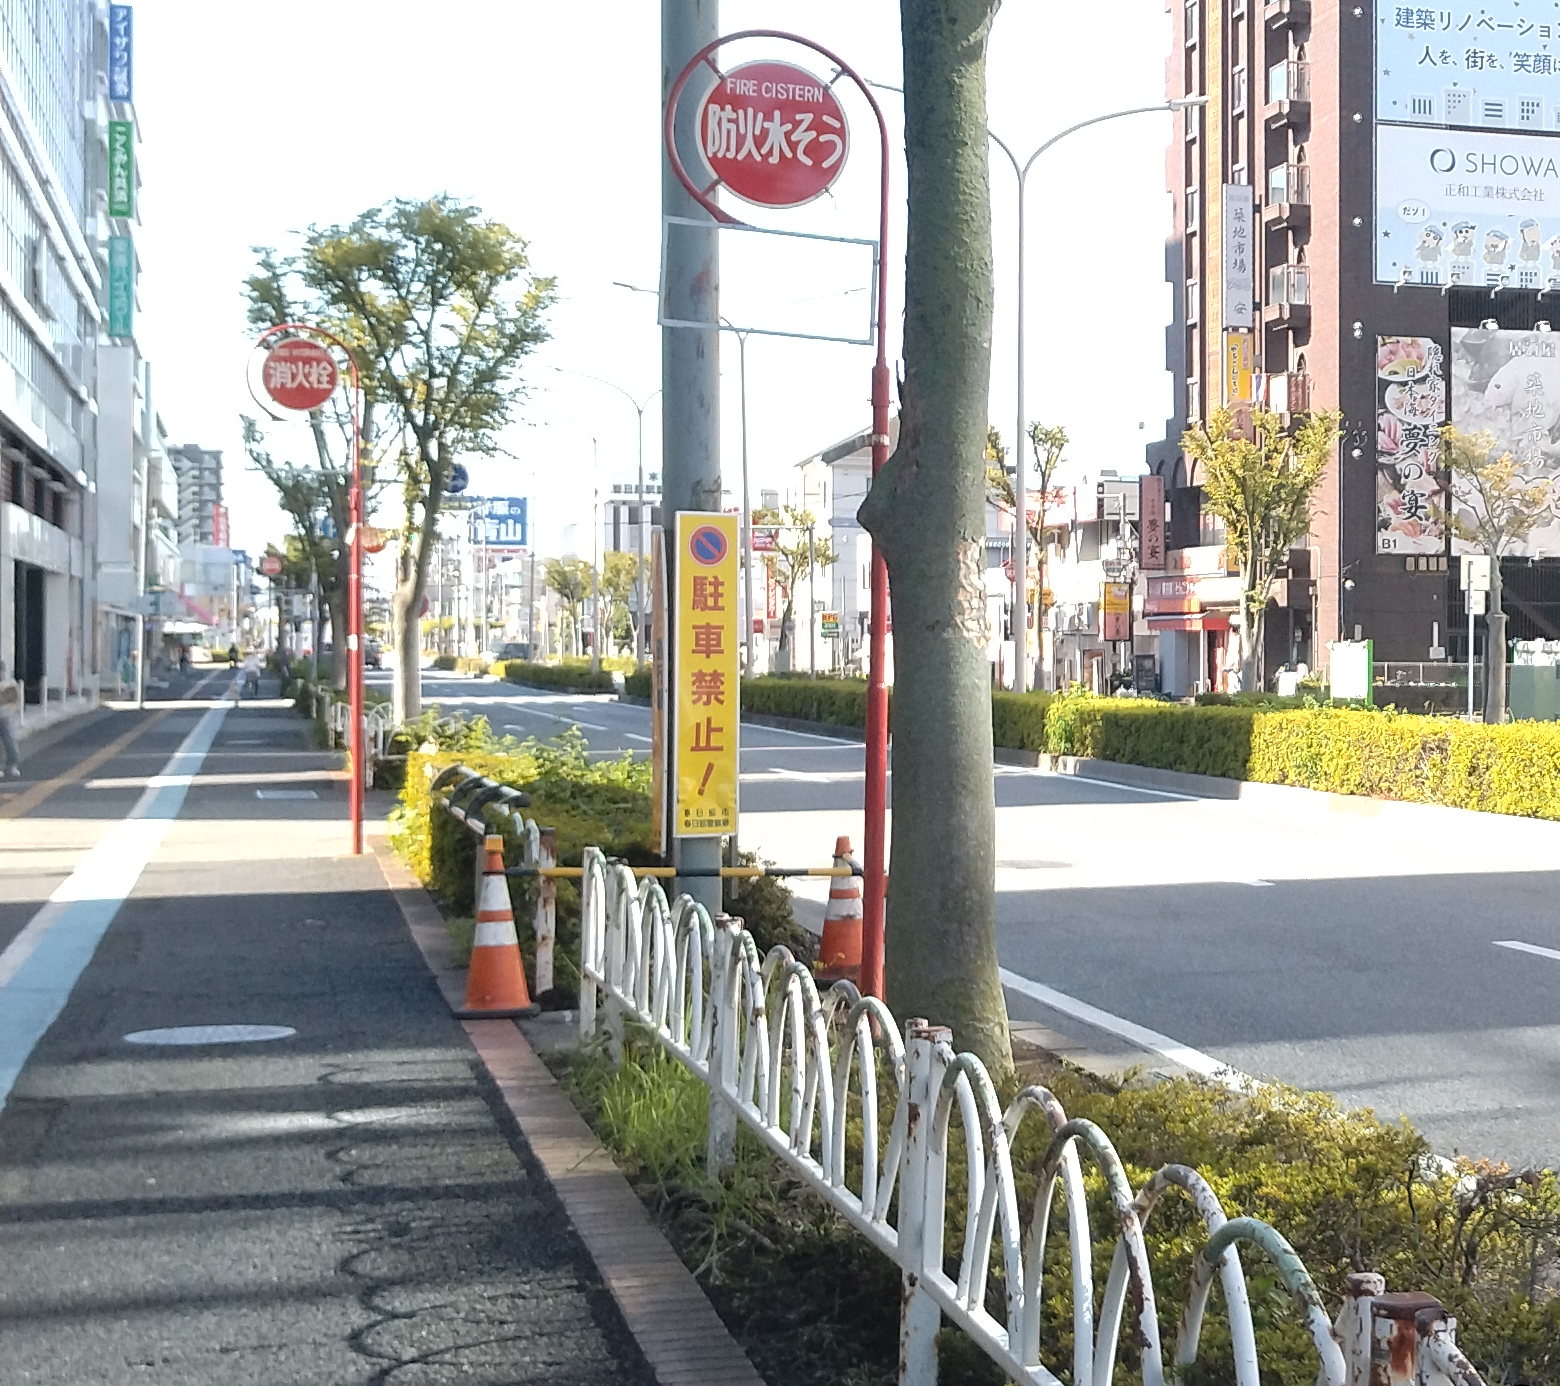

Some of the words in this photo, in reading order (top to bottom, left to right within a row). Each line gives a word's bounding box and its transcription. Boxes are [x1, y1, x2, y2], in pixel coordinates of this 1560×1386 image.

[726, 78, 758, 98] FIRE
[762, 81, 823, 104] CISTERN
[708, 104, 843, 169] 防火水そう
[1465, 152, 1560, 180] SHOWA
[1444, 183, 1546, 203] 正和工業株式会社
[1232, 207, 1247, 274] 築地市場
[268, 360, 333, 389] 消火栓
[1400, 424, 1428, 521] 夢の宴
[1382, 538, 1397, 550] B1
